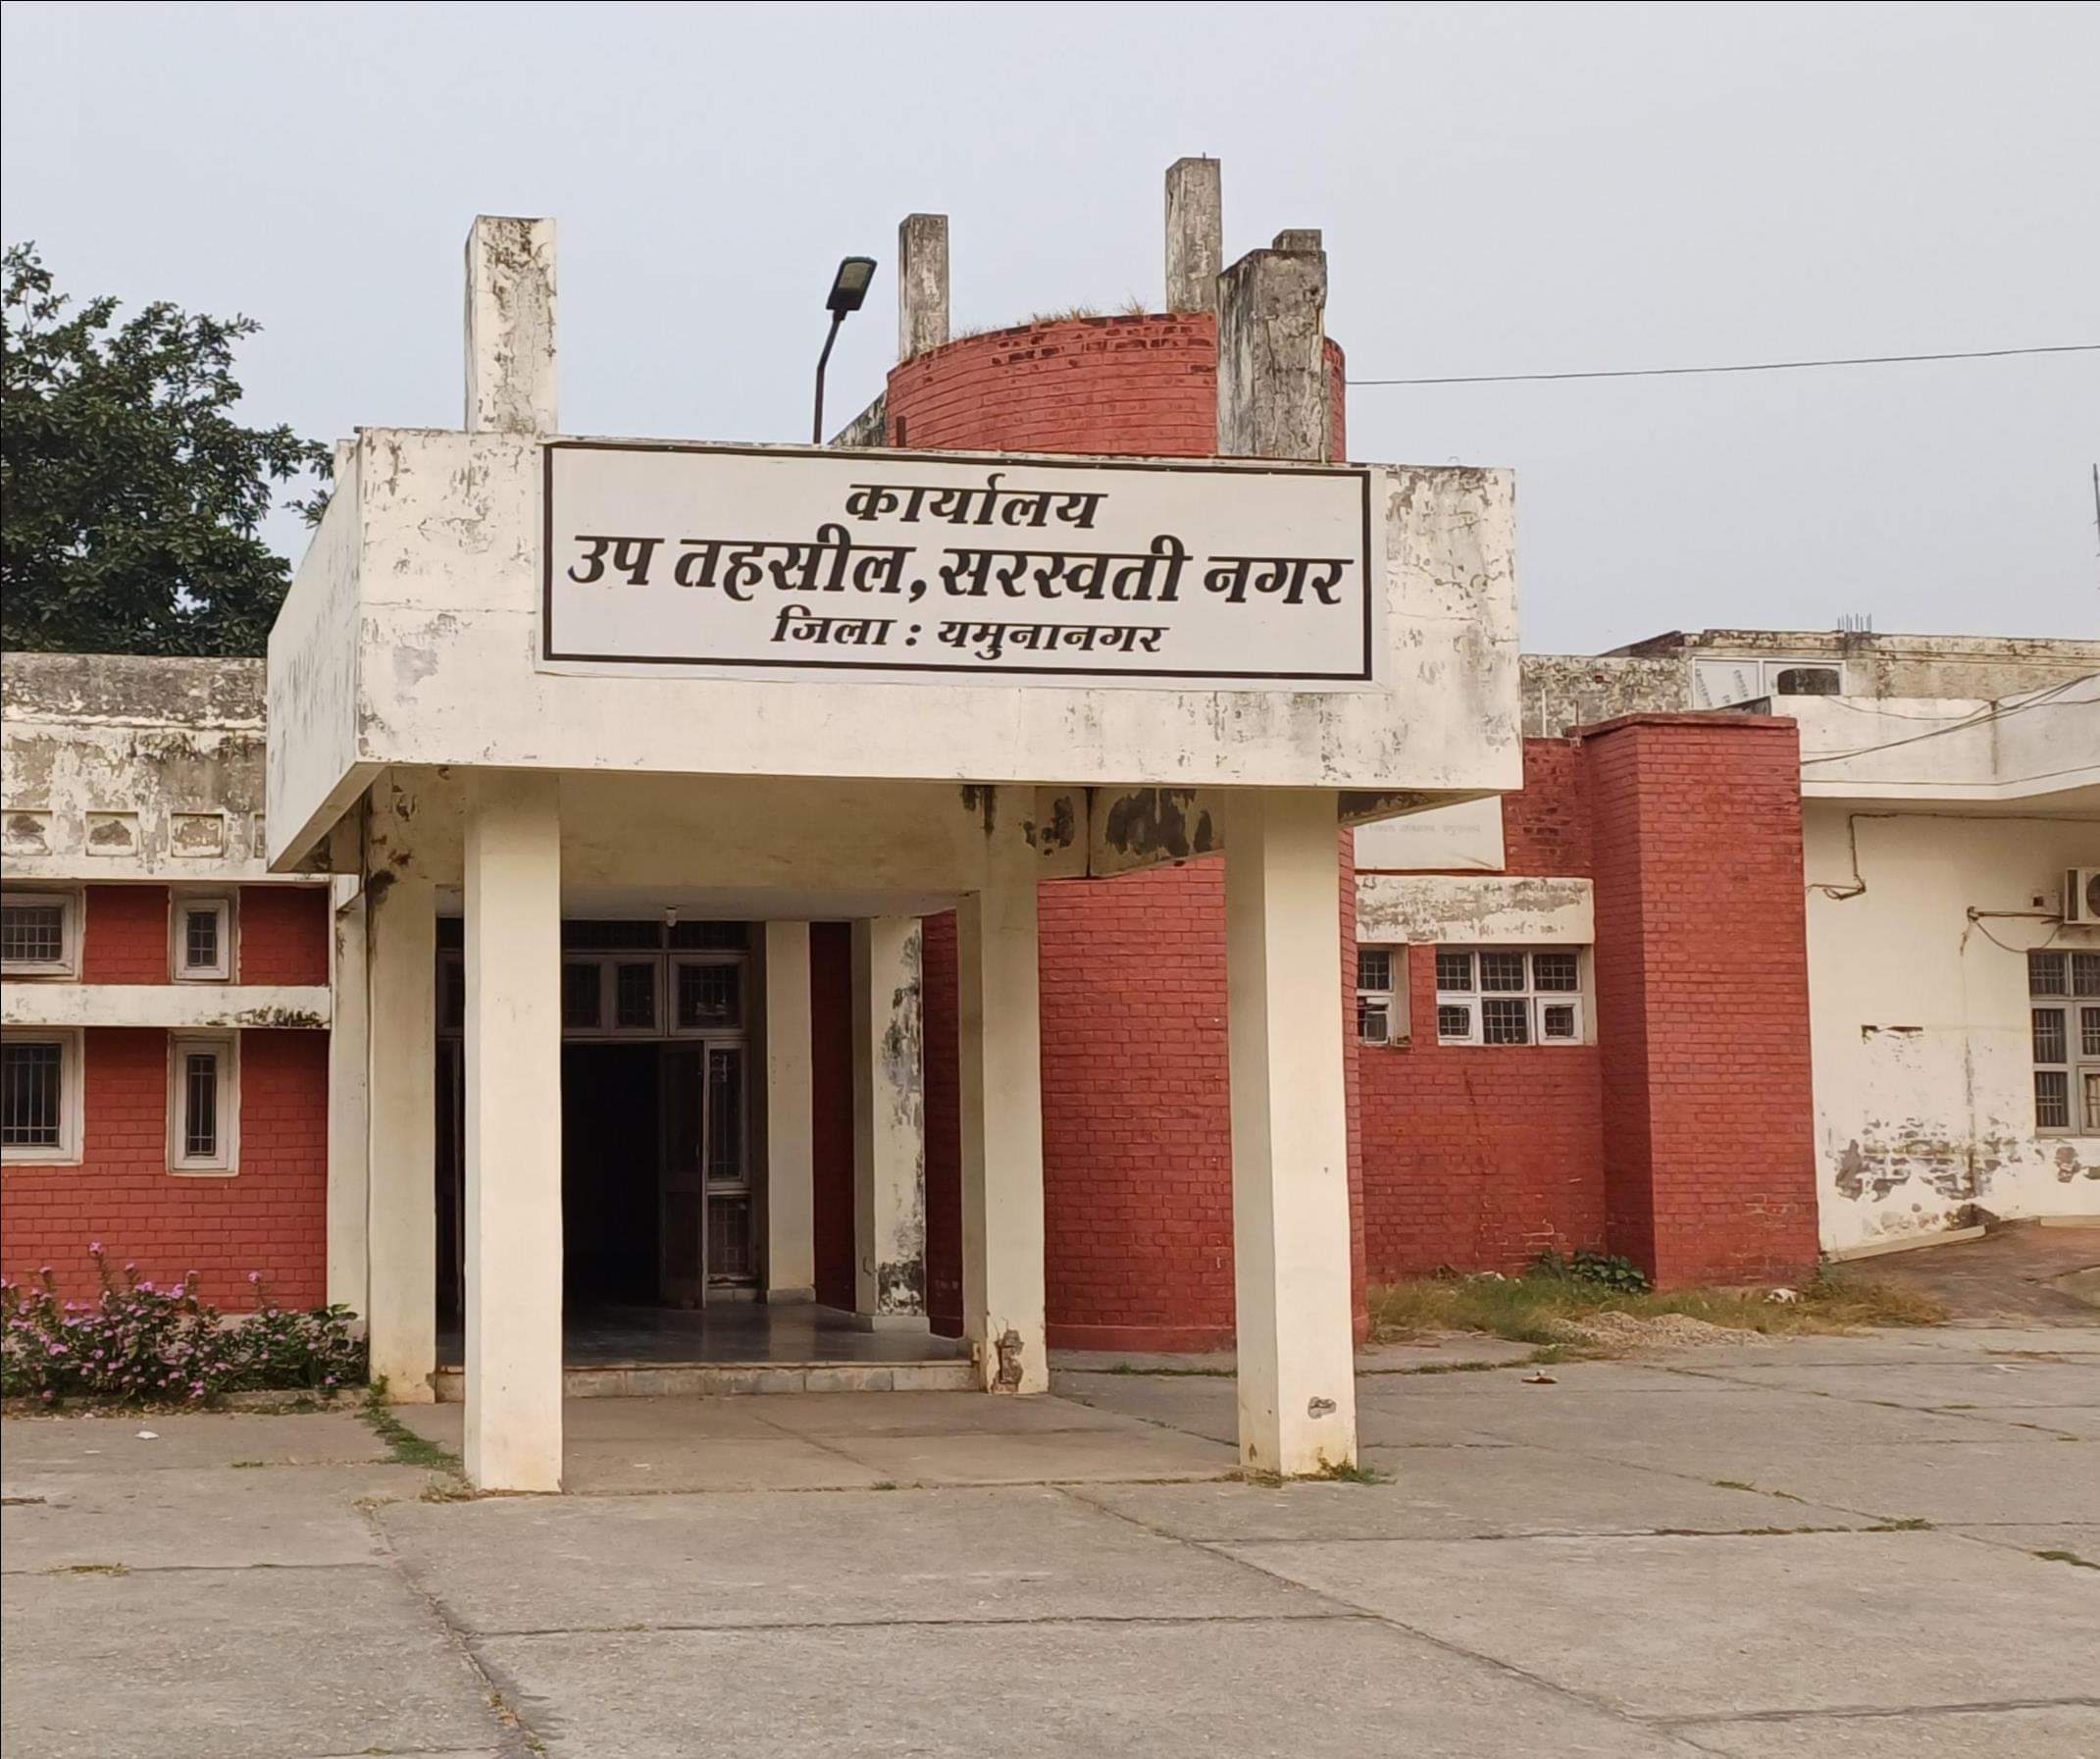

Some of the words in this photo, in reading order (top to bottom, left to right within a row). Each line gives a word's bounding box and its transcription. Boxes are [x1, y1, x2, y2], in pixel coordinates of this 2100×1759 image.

[845, 472, 1109, 529] कार्यालय
[566, 535, 665, 586] उप
[674, 523, 928, 603] तहसील,
[939, 534, 1194, 602] सरस्वती
[1204, 555, 1355, 605] नगर
[770, 603, 897, 646] जिला
[938, 621, 1170, 661] यमुनानगर
